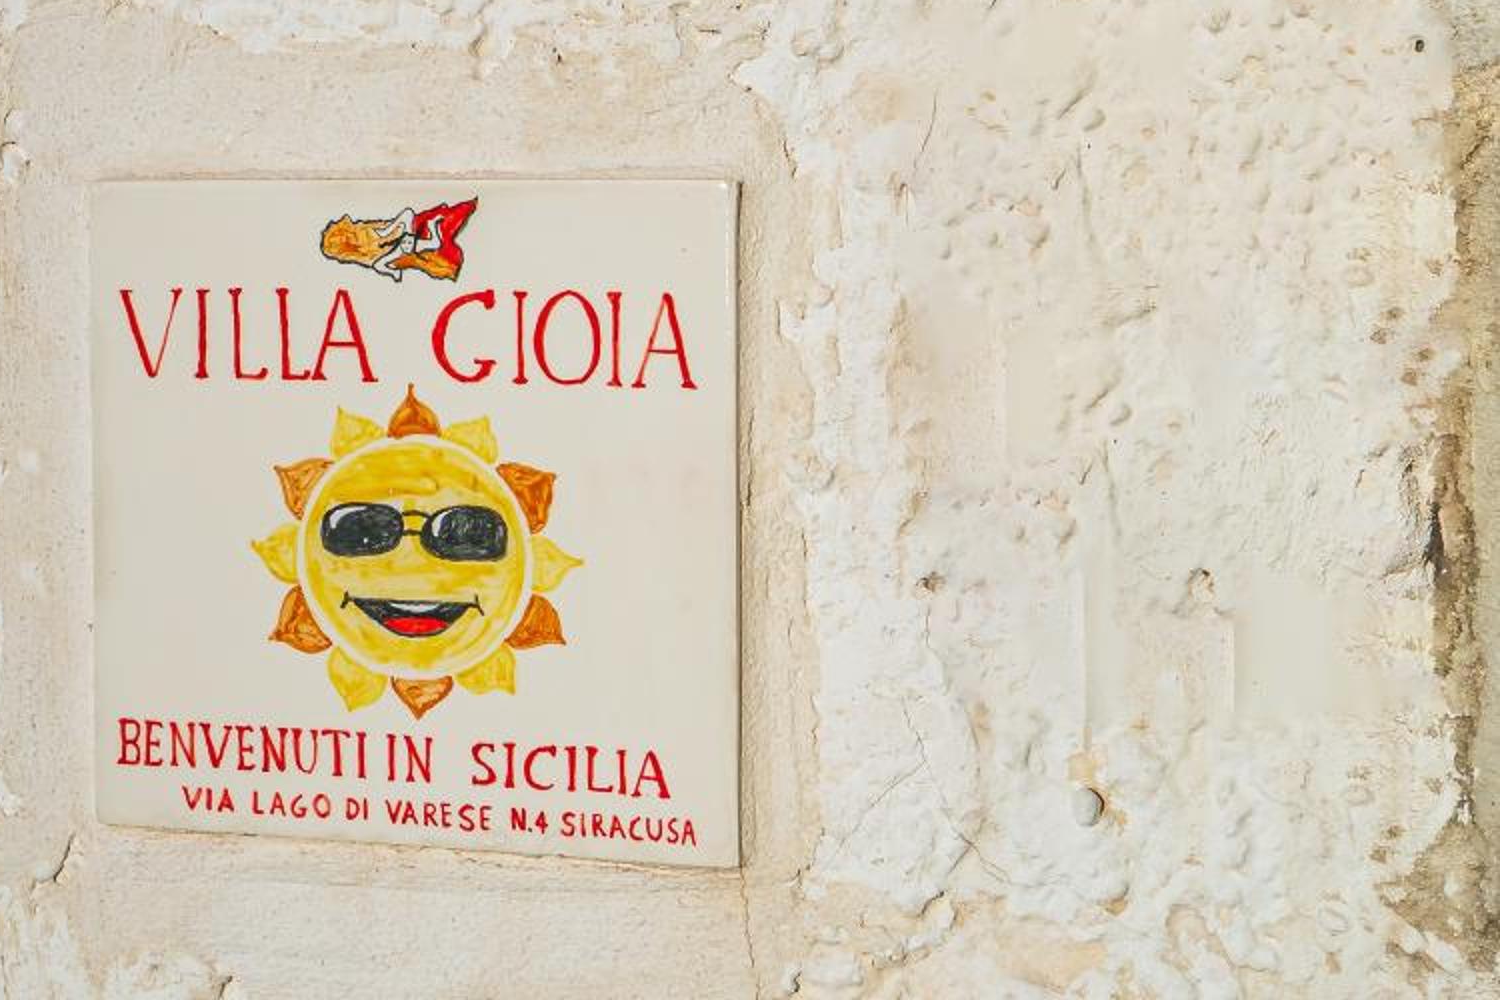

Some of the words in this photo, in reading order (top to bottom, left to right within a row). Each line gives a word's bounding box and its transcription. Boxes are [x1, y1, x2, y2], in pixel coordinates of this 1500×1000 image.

[119, 285, 379, 385] VILLA
[430, 287, 699, 391] GIOIA
[115, 716, 368, 779] BENVENUTI
[386, 732, 434, 784] IN
[470, 740, 672, 801] SICILIA
[180, 785, 235, 813] VIA
[250, 790, 332, 820] LAGO
[345, 796, 369, 821] DI
[384, 800, 492, 833] VARESE
[509, 806, 549, 835] N.4
[560, 810, 698, 848] SIRACUSA
